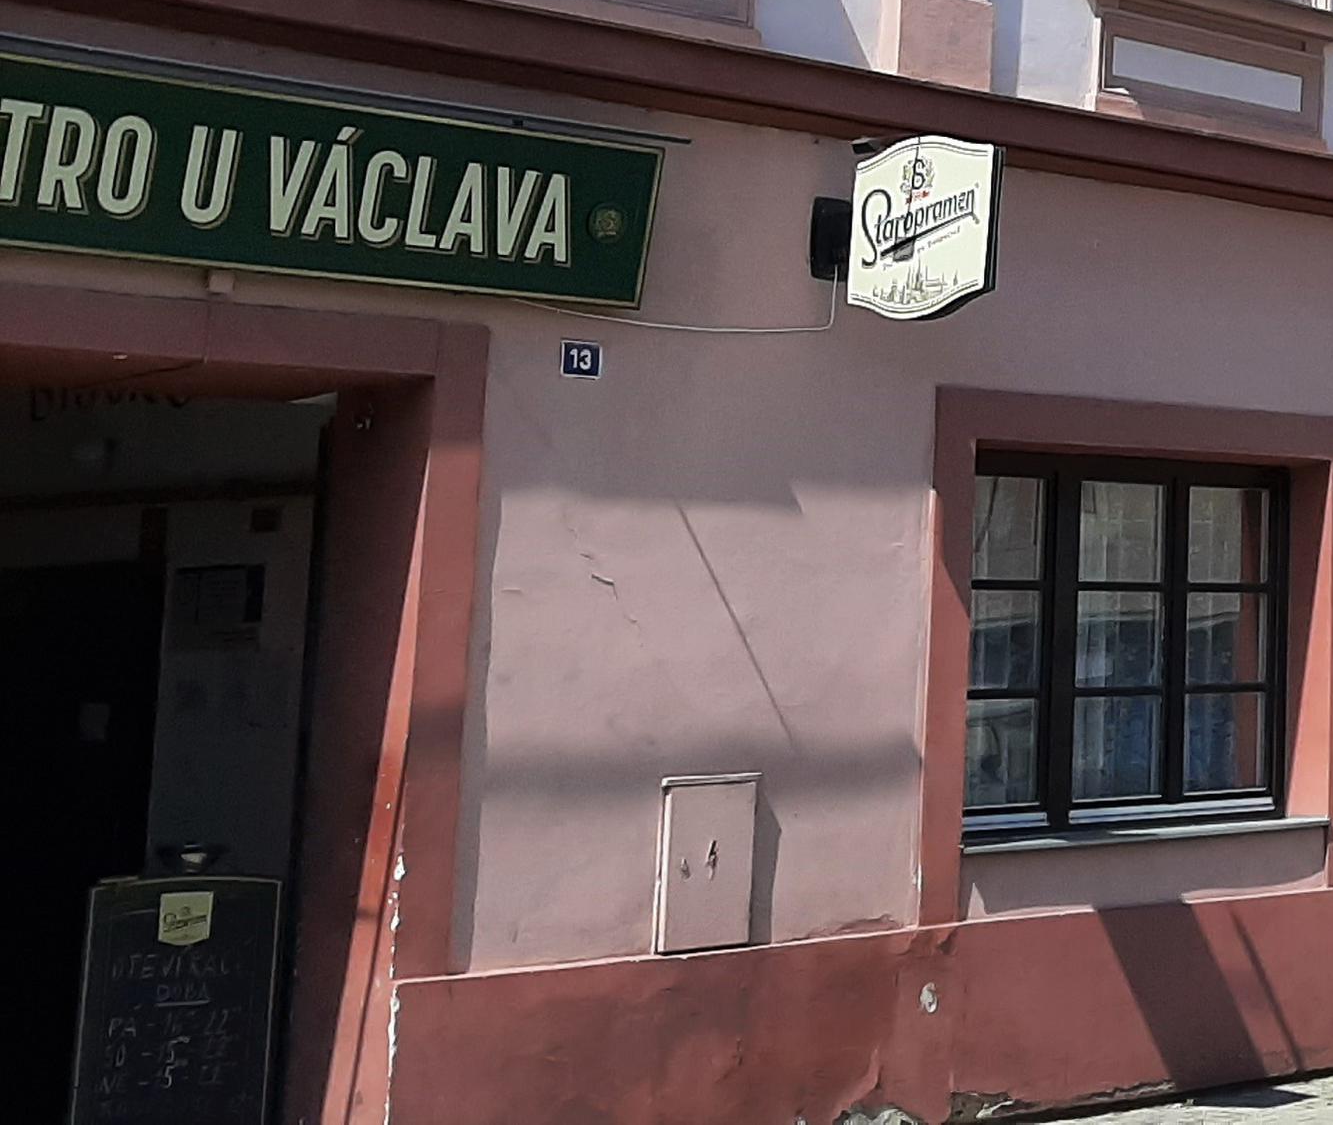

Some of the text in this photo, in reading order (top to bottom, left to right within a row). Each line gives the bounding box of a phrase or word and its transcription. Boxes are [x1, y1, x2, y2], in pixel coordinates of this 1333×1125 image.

[0, 97, 572, 265] TRO U VÁCLAVA
[861, 187, 980, 269] Staropramen
[569, 348, 592, 371] 13
